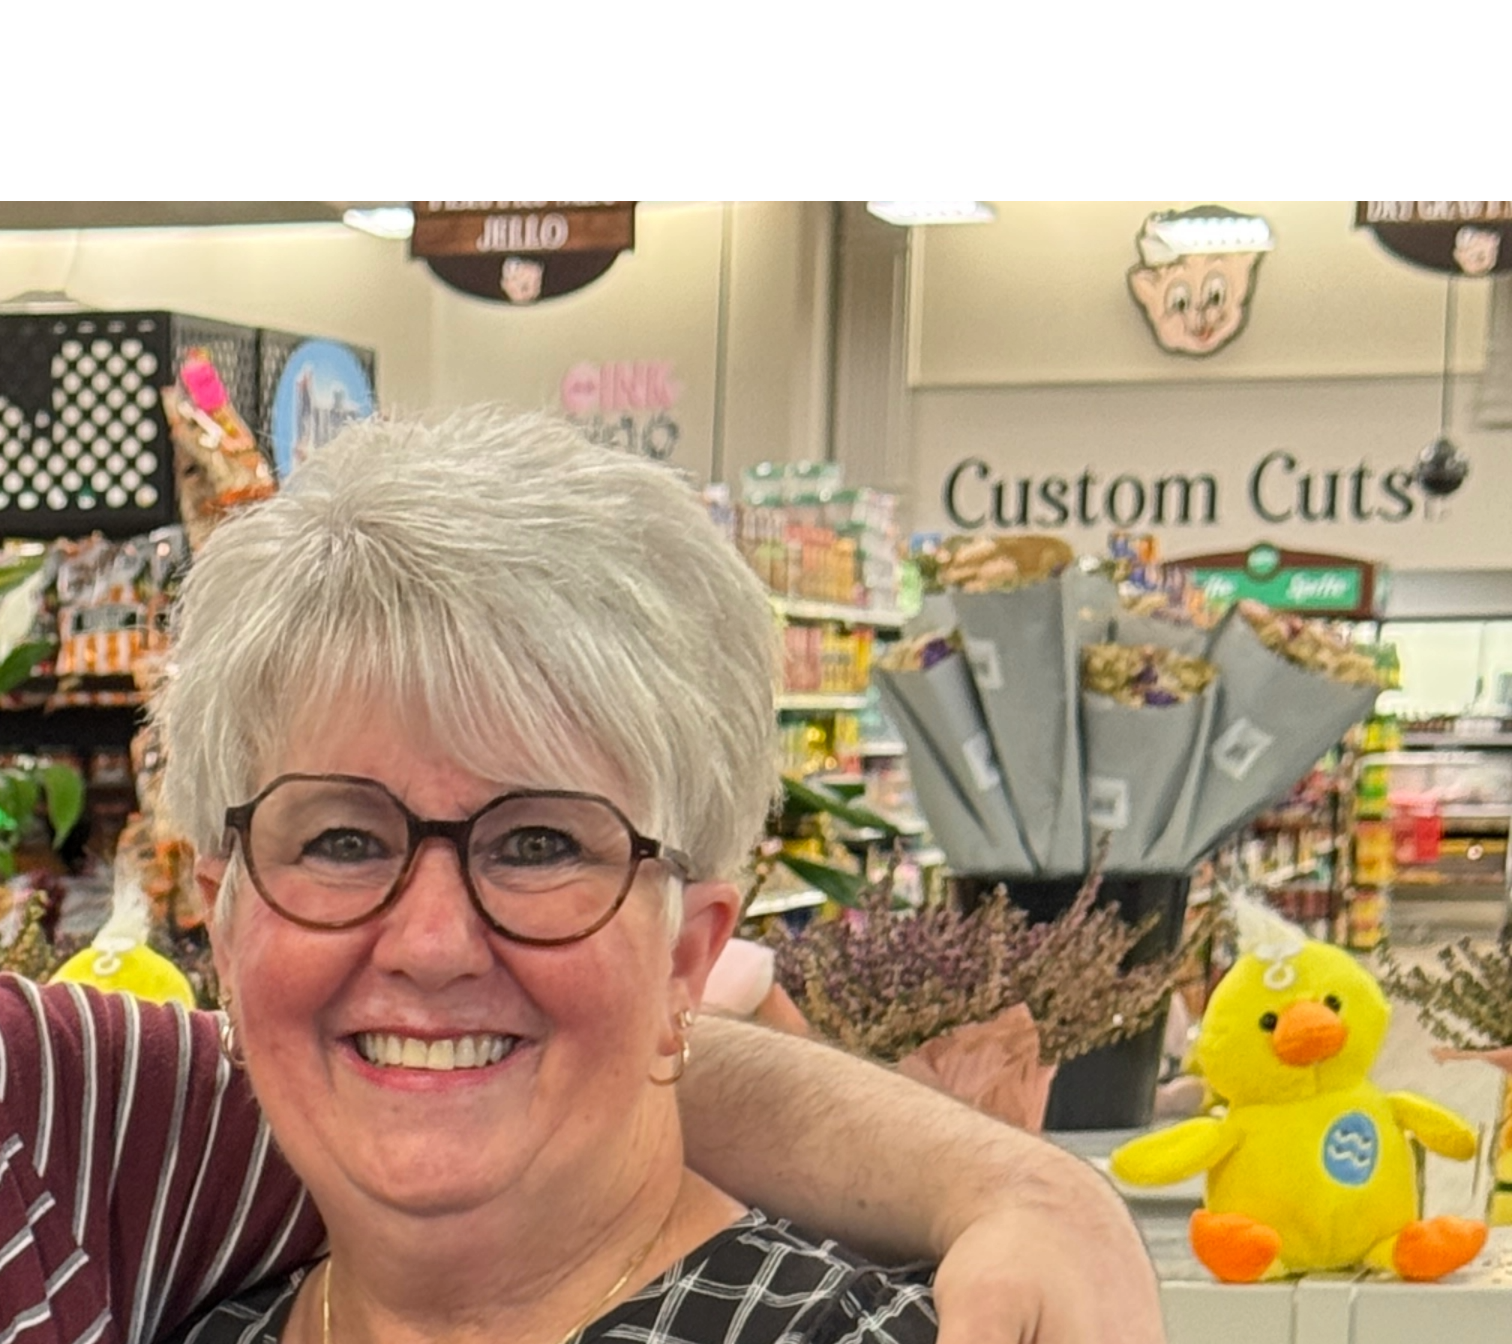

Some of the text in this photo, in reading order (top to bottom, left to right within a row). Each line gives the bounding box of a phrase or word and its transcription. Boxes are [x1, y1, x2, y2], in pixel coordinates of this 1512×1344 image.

[476, 213, 569, 252] JELLO
[944, 449, 1416, 529] Custom Cuts
